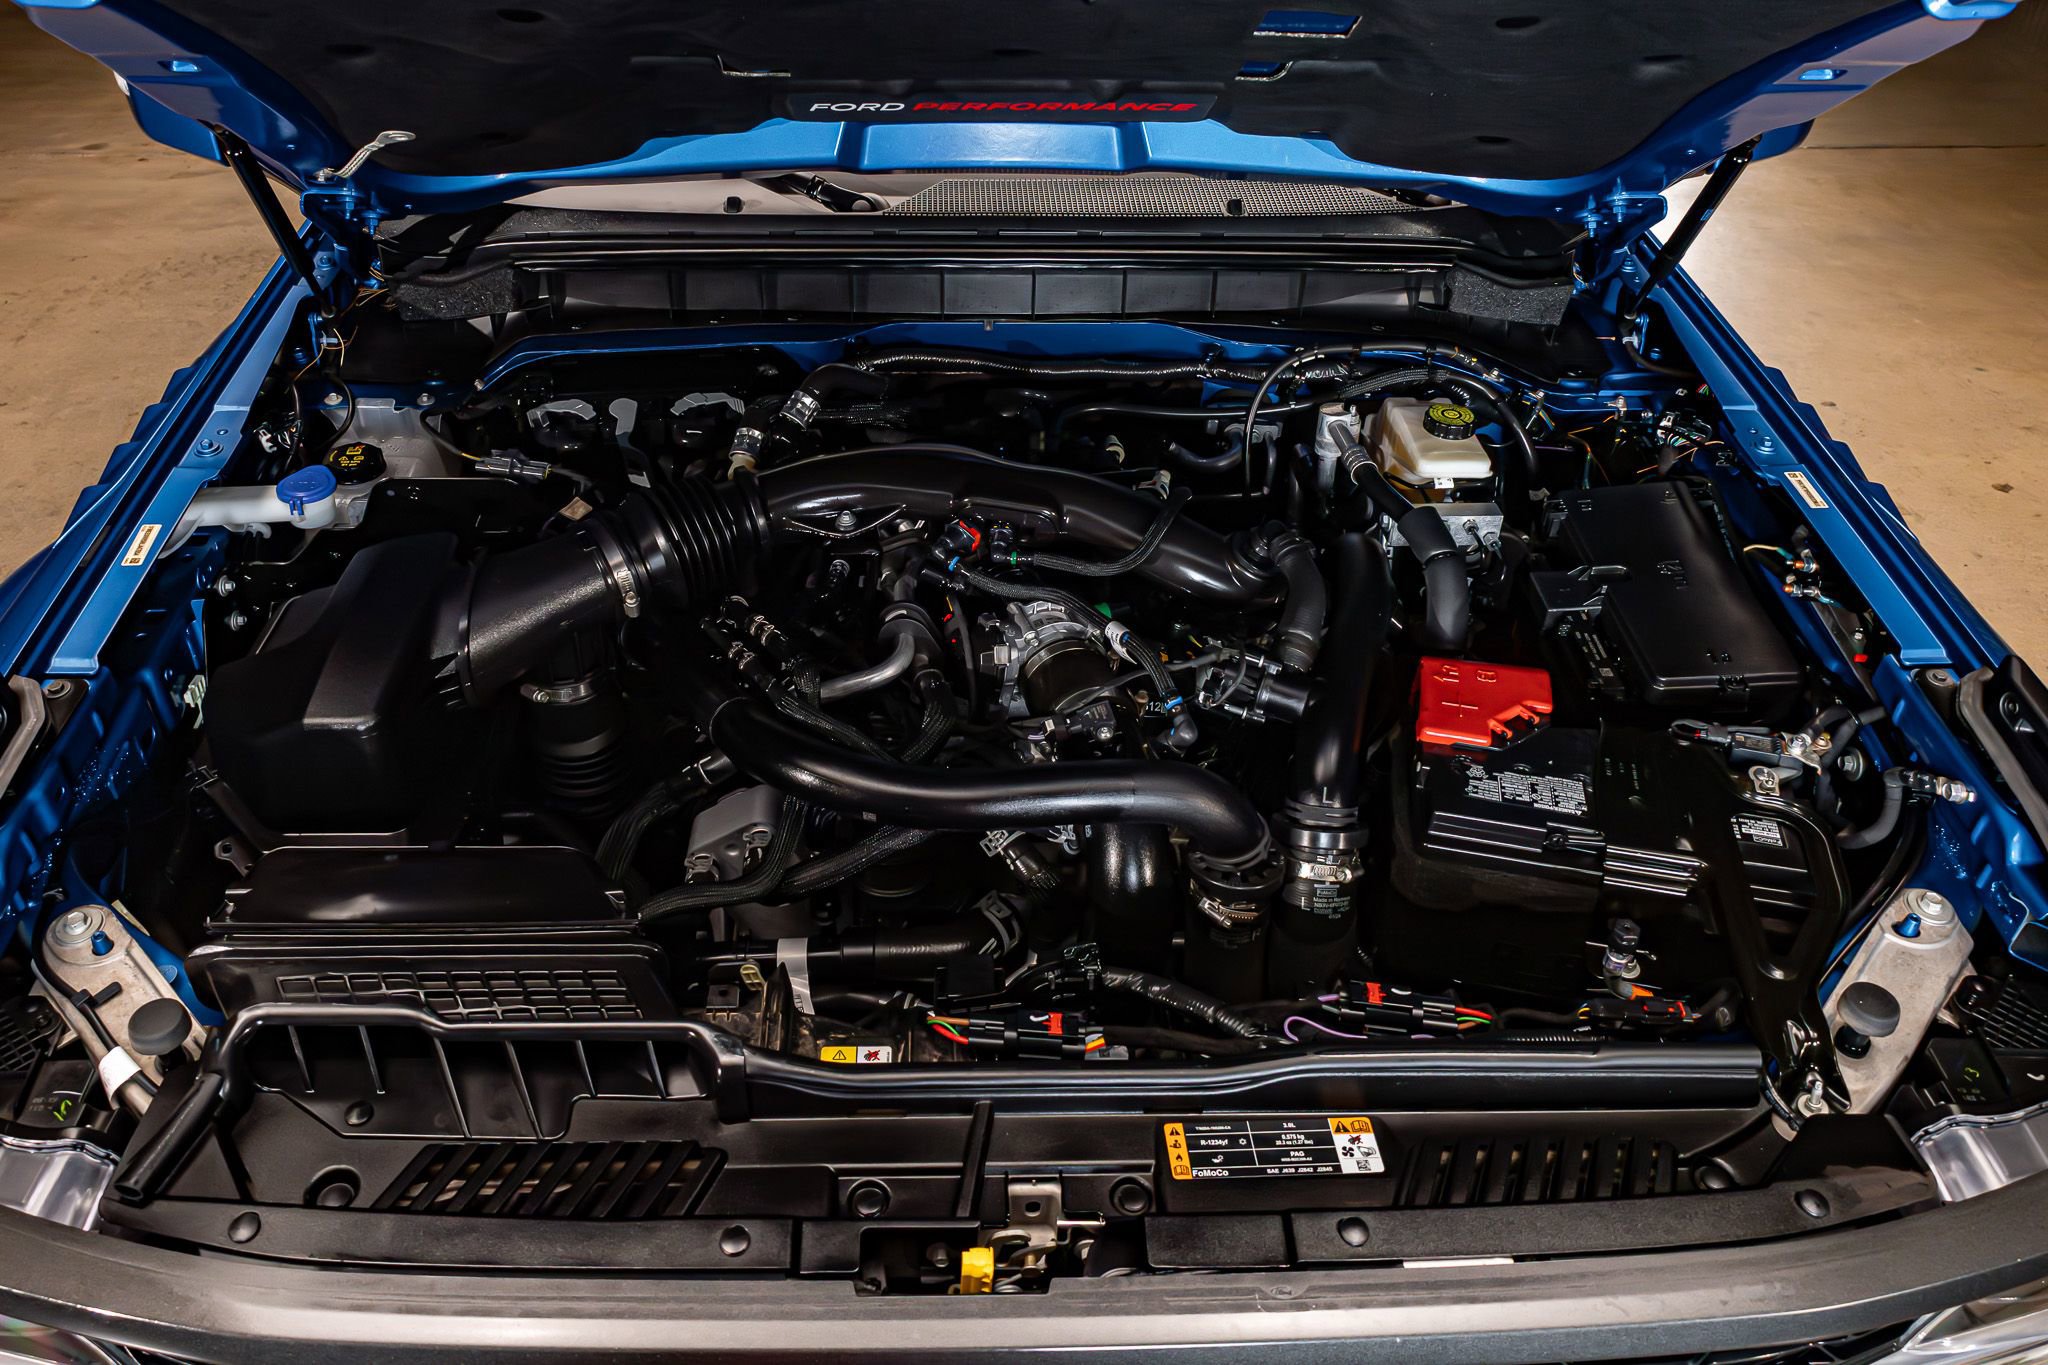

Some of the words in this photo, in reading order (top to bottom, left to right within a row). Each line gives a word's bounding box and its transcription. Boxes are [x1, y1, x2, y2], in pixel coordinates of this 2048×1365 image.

[810, 102, 905, 112] FORD
[912, 102, 1199, 112] PERFORMANCE
[1192, 1169, 1229, 1177] FoMoCo
